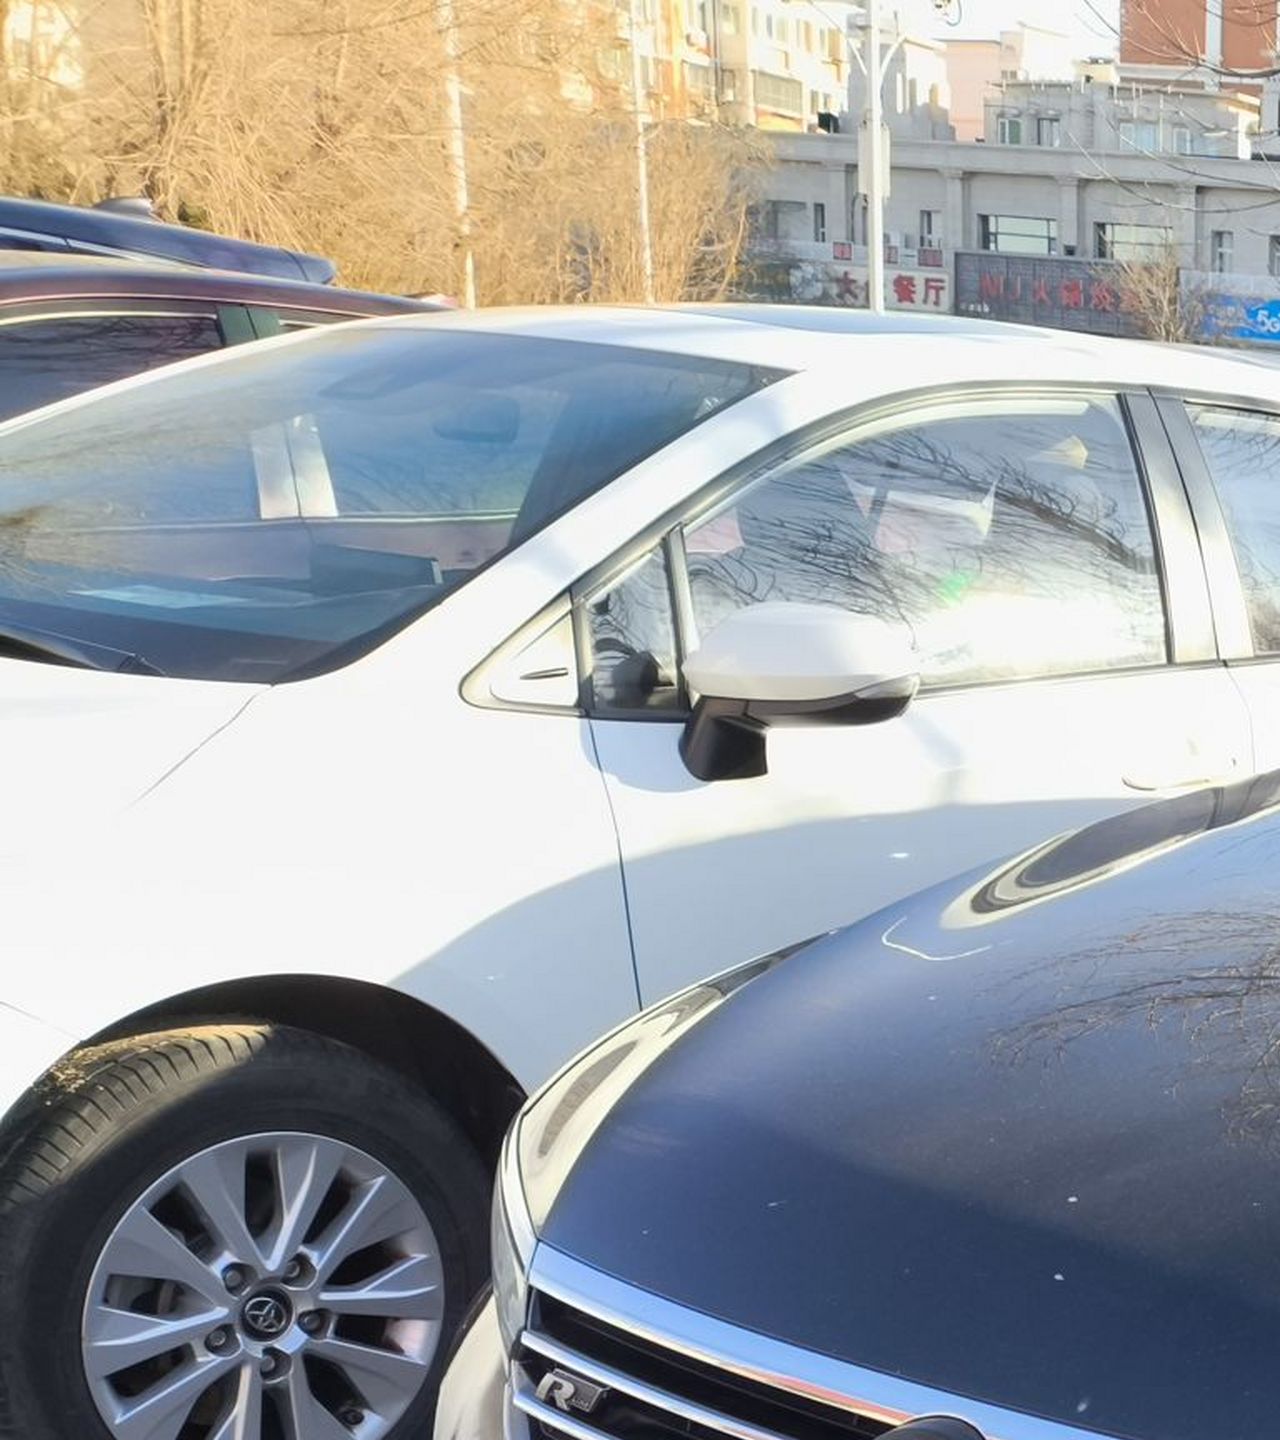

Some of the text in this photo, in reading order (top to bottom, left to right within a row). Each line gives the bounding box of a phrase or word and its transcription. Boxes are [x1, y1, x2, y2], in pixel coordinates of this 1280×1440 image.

[836, 270, 945, 306] 大餐厅
[535, 1372, 570, 1411] R
